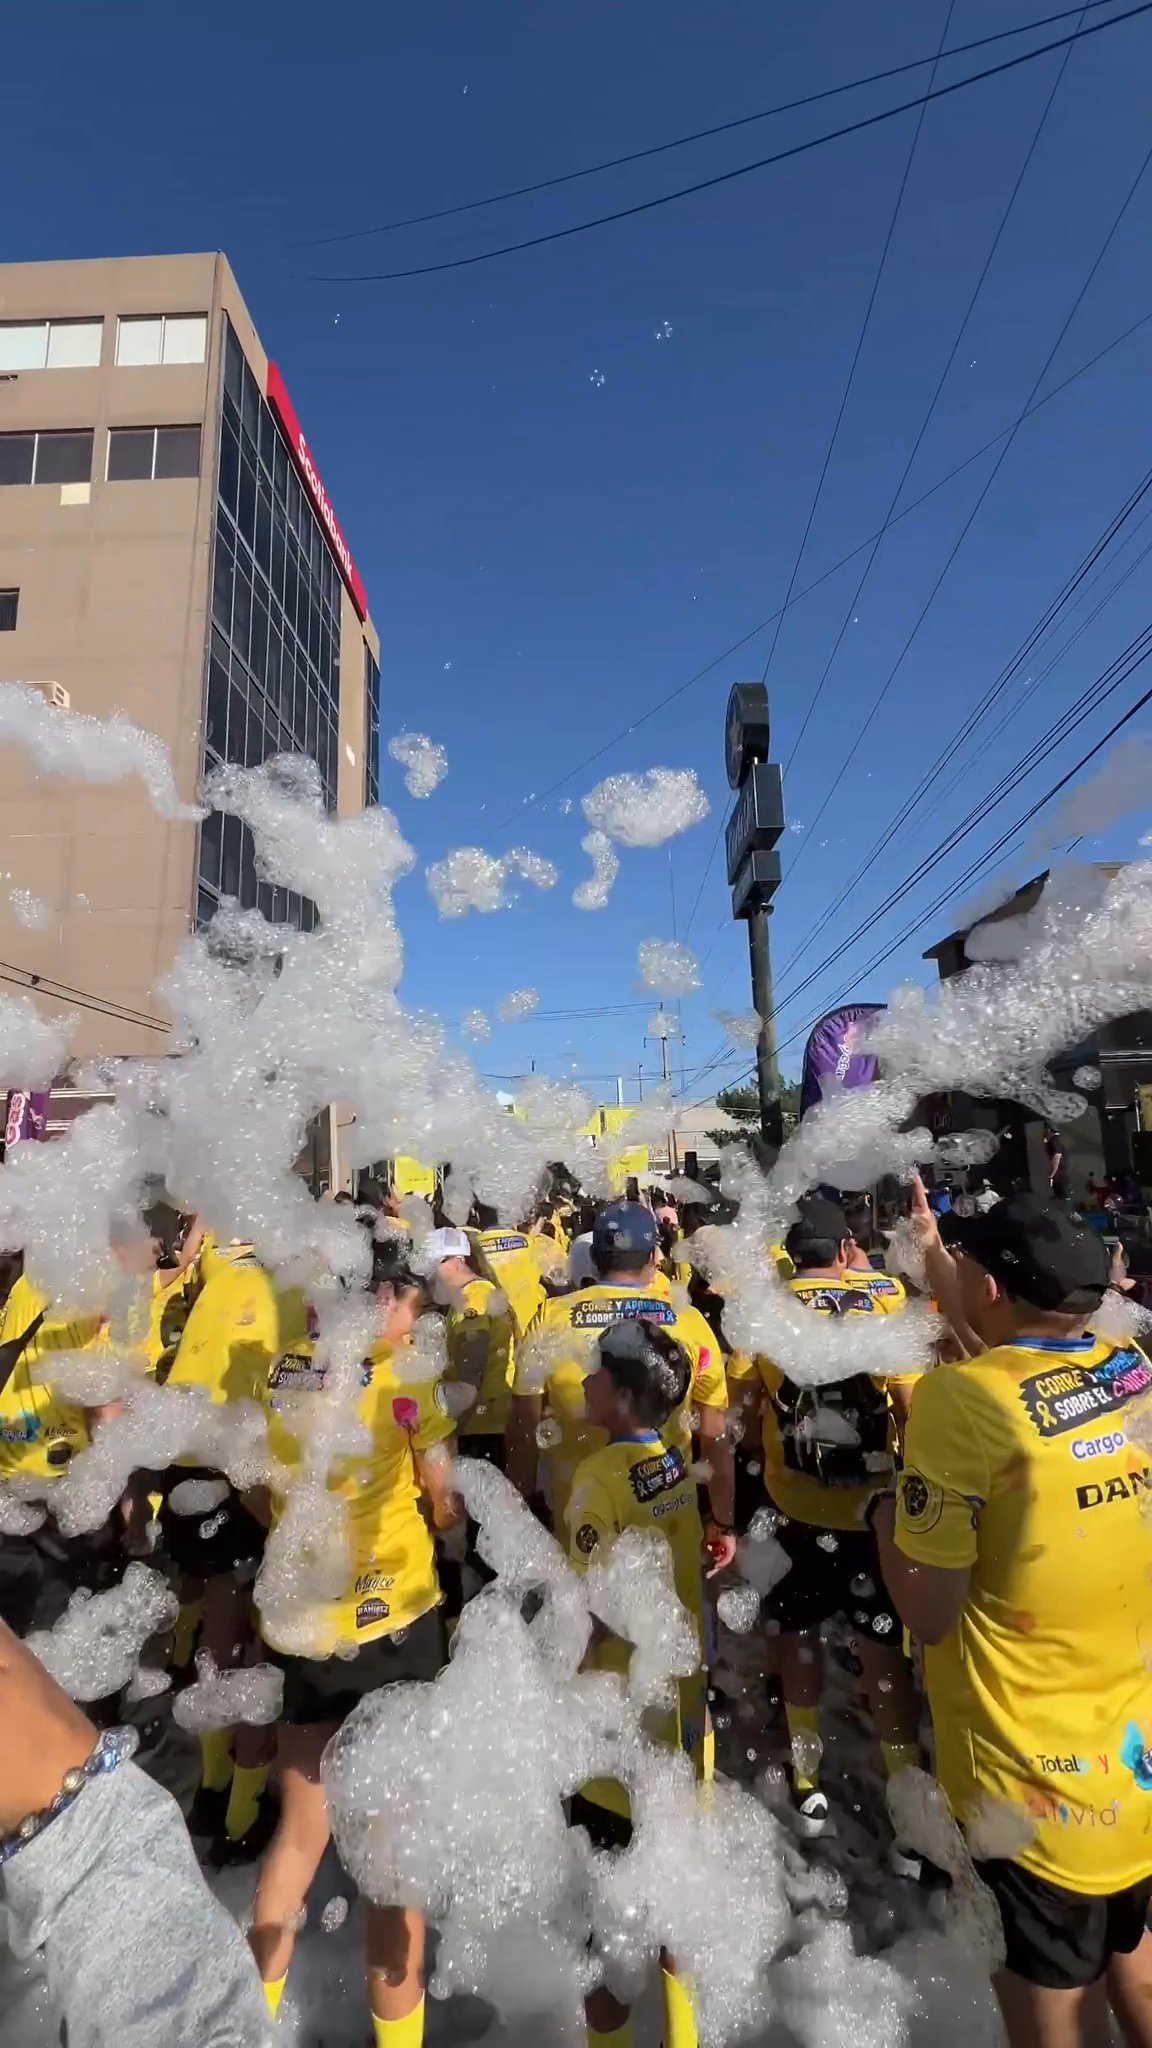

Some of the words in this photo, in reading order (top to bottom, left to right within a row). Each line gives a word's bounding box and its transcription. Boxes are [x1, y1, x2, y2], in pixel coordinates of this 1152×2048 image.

[297, 432, 353, 582] Scotiabank
[615, 1300, 623, 1311] Y
[1035, 1369, 1085, 1399] CORRE
[1054, 1391, 1099, 1420] SOBRE
[1092, 1386, 1113, 1404] EL
[1072, 1432, 1124, 1460] Cargo
